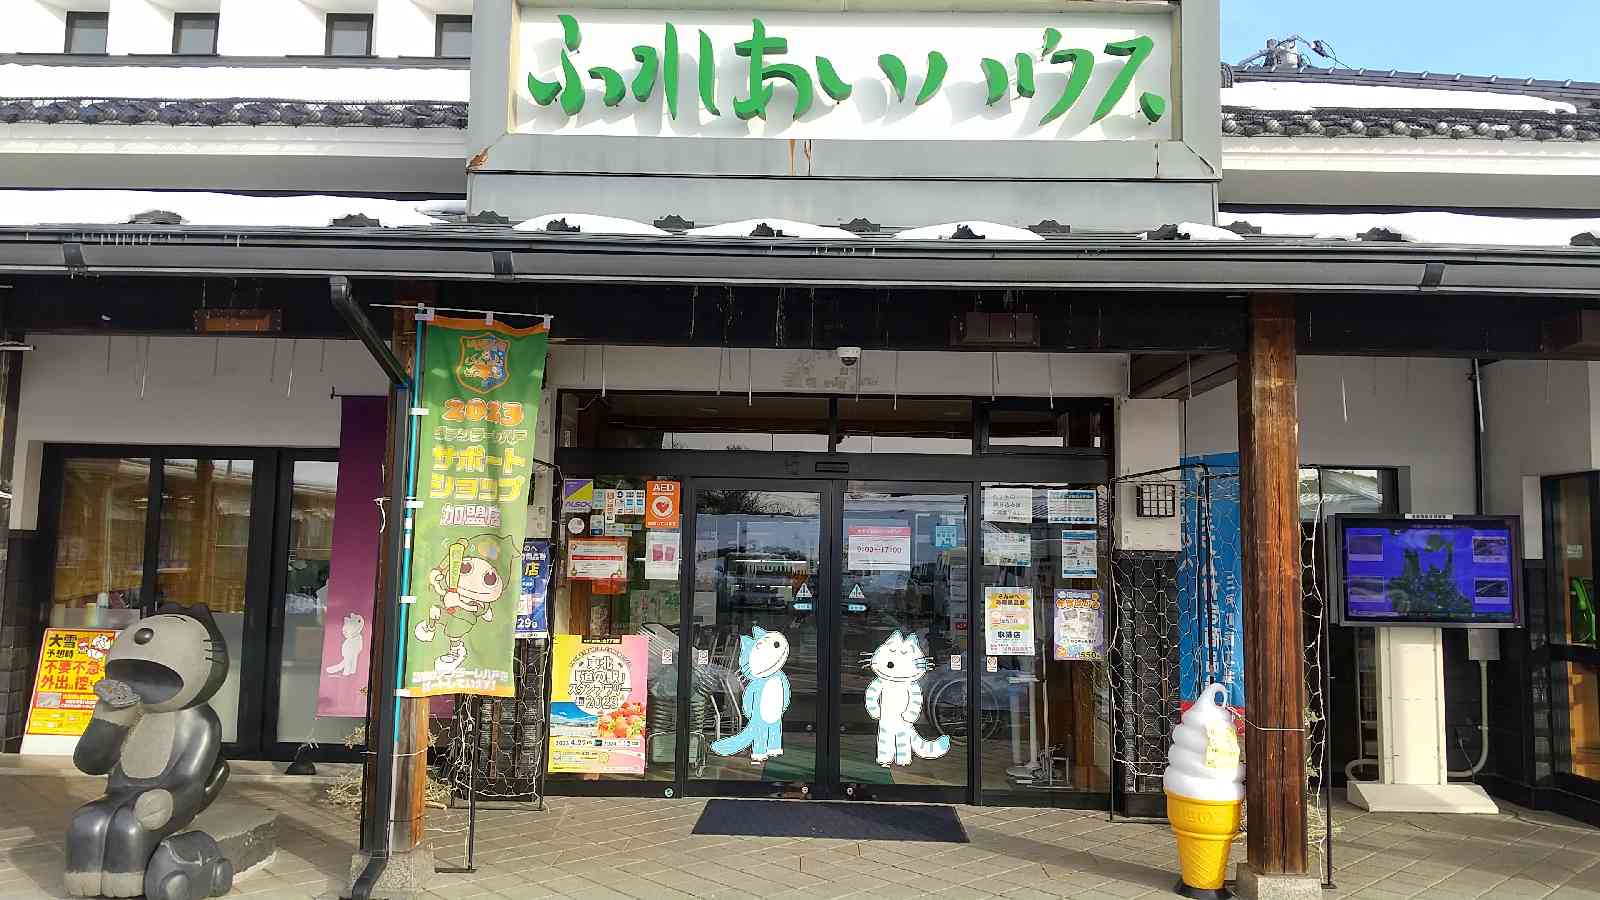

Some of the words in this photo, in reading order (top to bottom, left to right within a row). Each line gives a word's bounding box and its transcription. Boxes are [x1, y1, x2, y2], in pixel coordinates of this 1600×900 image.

[528, 14, 1166, 127] ふれあいハウス
[442, 399, 525, 426] 2023
[431, 445, 526, 475] サポート
[430, 473, 526, 502] ショップ
[653, 483, 675, 492] AED
[440, 503, 501, 528] 加盟店
[48, 633, 78, 649] 大雪
[46, 648, 75, 659] 予想時
[587, 655, 614, 670] 東北
[568, 682, 633, 697] スタンプラリー
[585, 695, 620, 709] 2023
